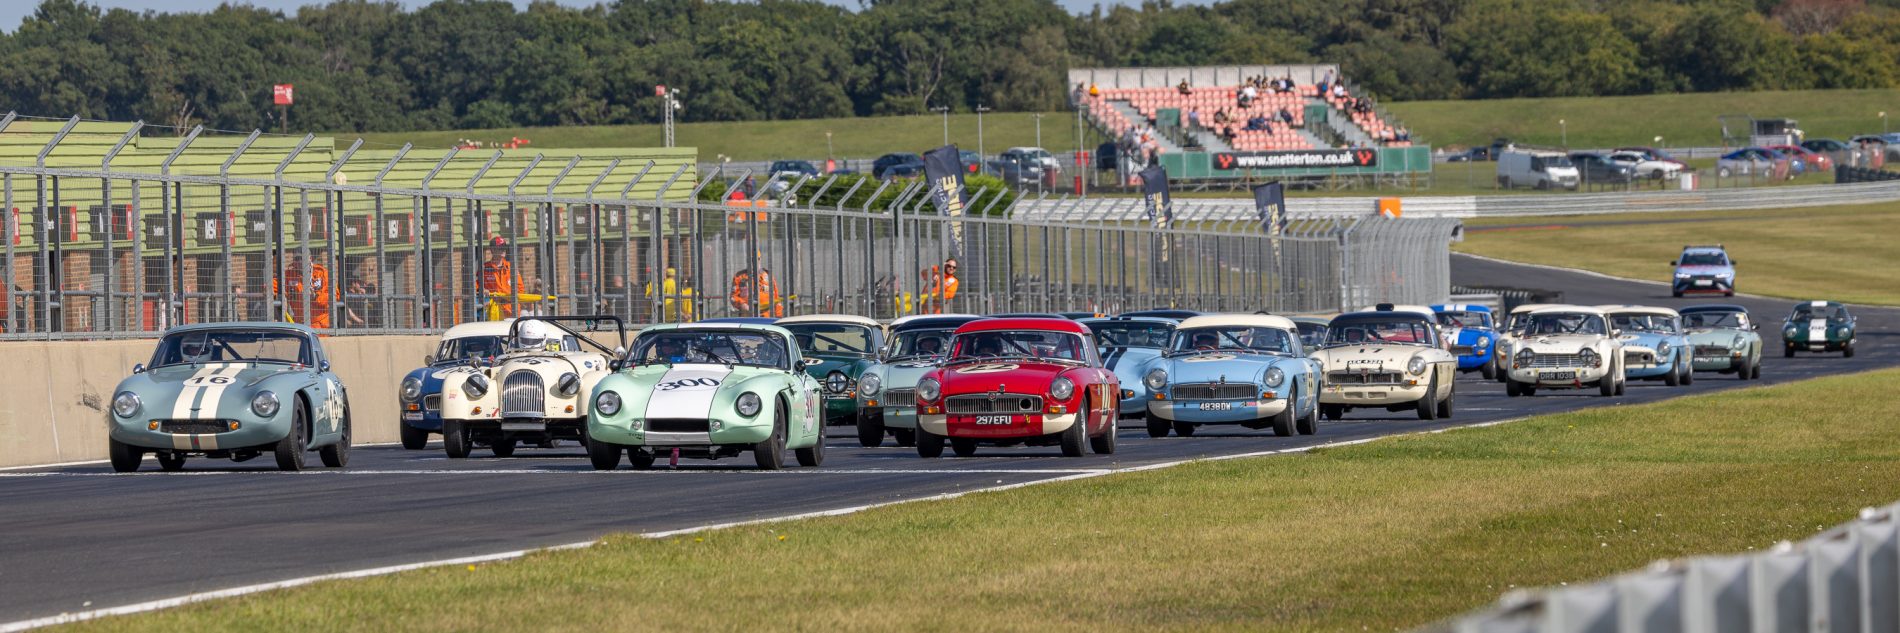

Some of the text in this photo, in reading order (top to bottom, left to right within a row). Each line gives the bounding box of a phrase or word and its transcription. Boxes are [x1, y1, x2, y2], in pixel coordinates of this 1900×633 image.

[1237, 151, 1354, 168] www.snetterton.co.uk
[191, 376, 229, 384] 16
[657, 377, 720, 391] 300
[976, 415, 1012, 425] 297EFU
